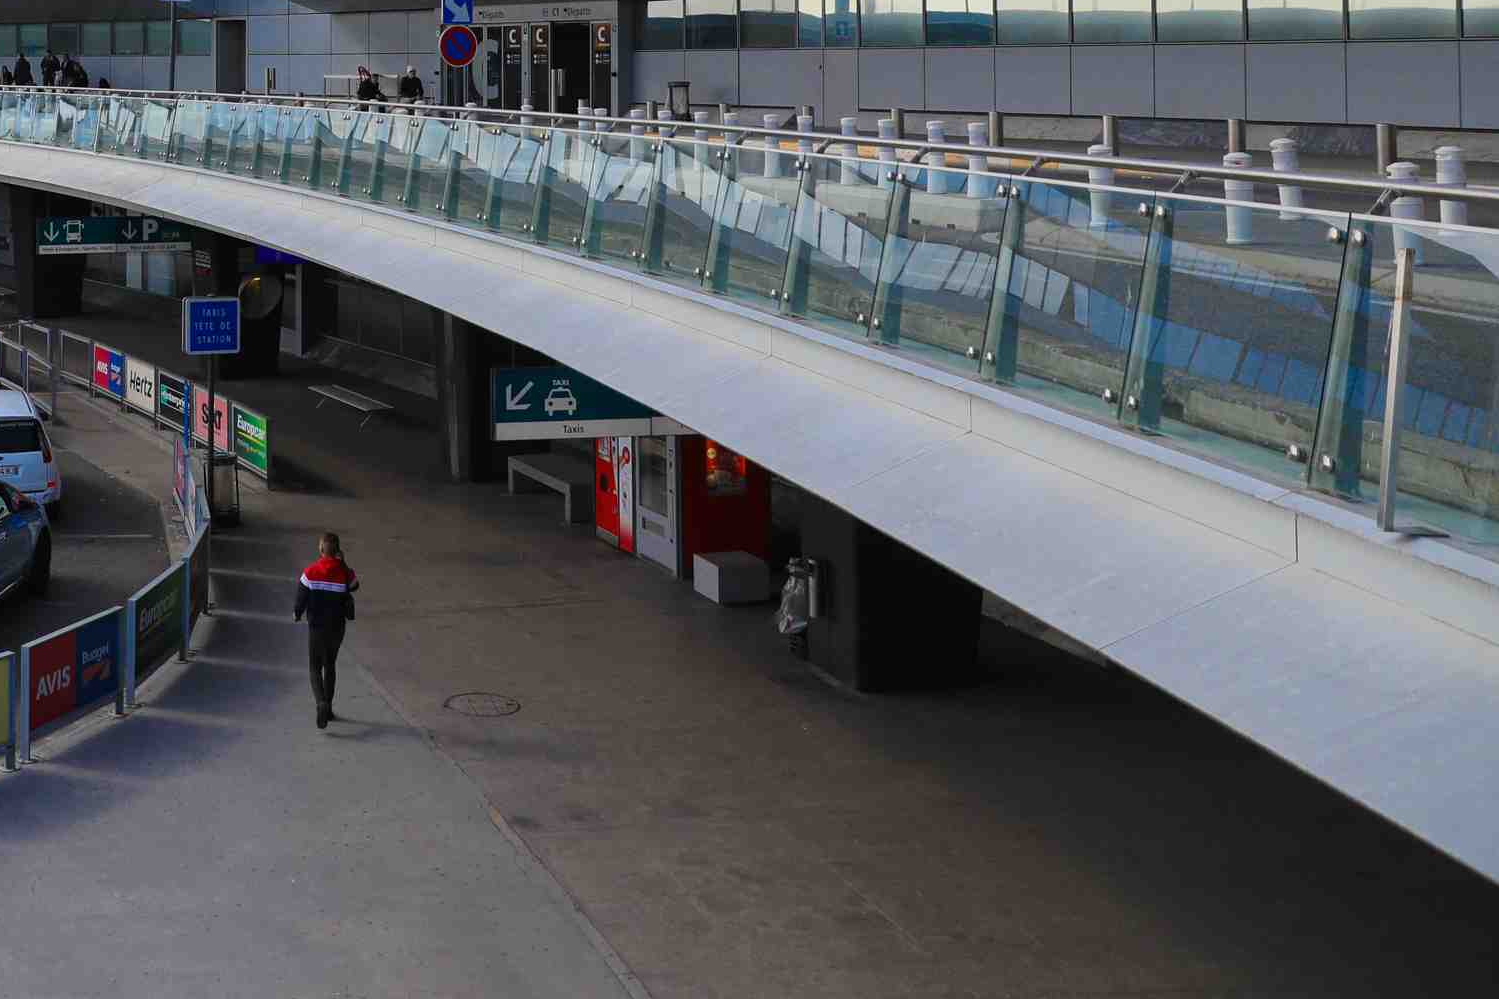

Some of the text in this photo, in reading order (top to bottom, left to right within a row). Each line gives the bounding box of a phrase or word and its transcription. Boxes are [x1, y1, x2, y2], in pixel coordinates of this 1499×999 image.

[509, 29, 517, 44] C
[535, 28, 543, 43] C
[597, 26, 605, 42] C
[143, 218, 159, 241] P
[196, 335, 231, 345] STATION
[129, 370, 153, 398] Hertz
[202, 403, 222, 430] SXT
[563, 424, 584, 434] Taxis
[36, 664, 71, 702] AVIS
